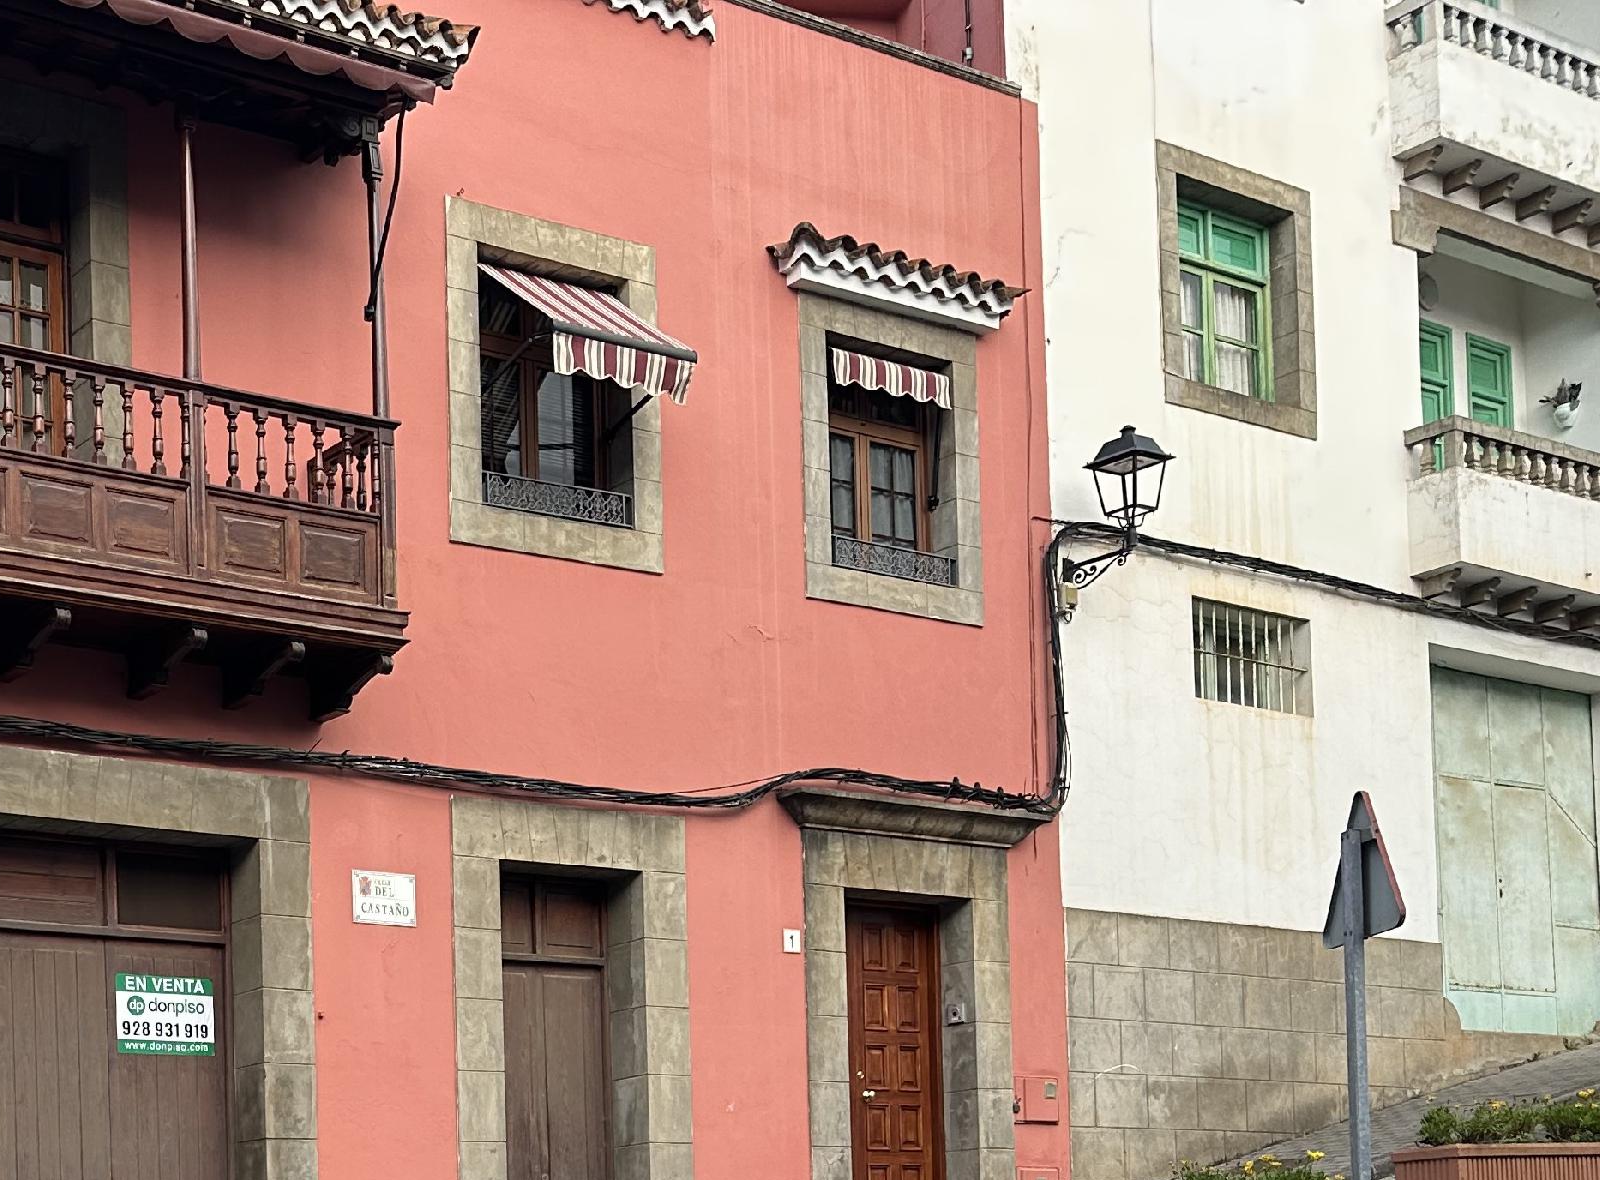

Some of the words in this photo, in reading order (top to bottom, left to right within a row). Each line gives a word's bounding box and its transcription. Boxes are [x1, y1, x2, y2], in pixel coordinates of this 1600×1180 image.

[375, 886, 394, 897] DEL
[361, 902, 409, 917] CASTAÑO
[125, 975, 147, 991] EN
[152, 977, 205, 994] VENTA
[148, 997, 205, 1017] donpiso
[122, 1020, 151, 1036] 928
[155, 1022, 180, 1038] 931
[185, 1024, 208, 1039] 919
[125, 1041, 209, 1052] www.donpiso.com
